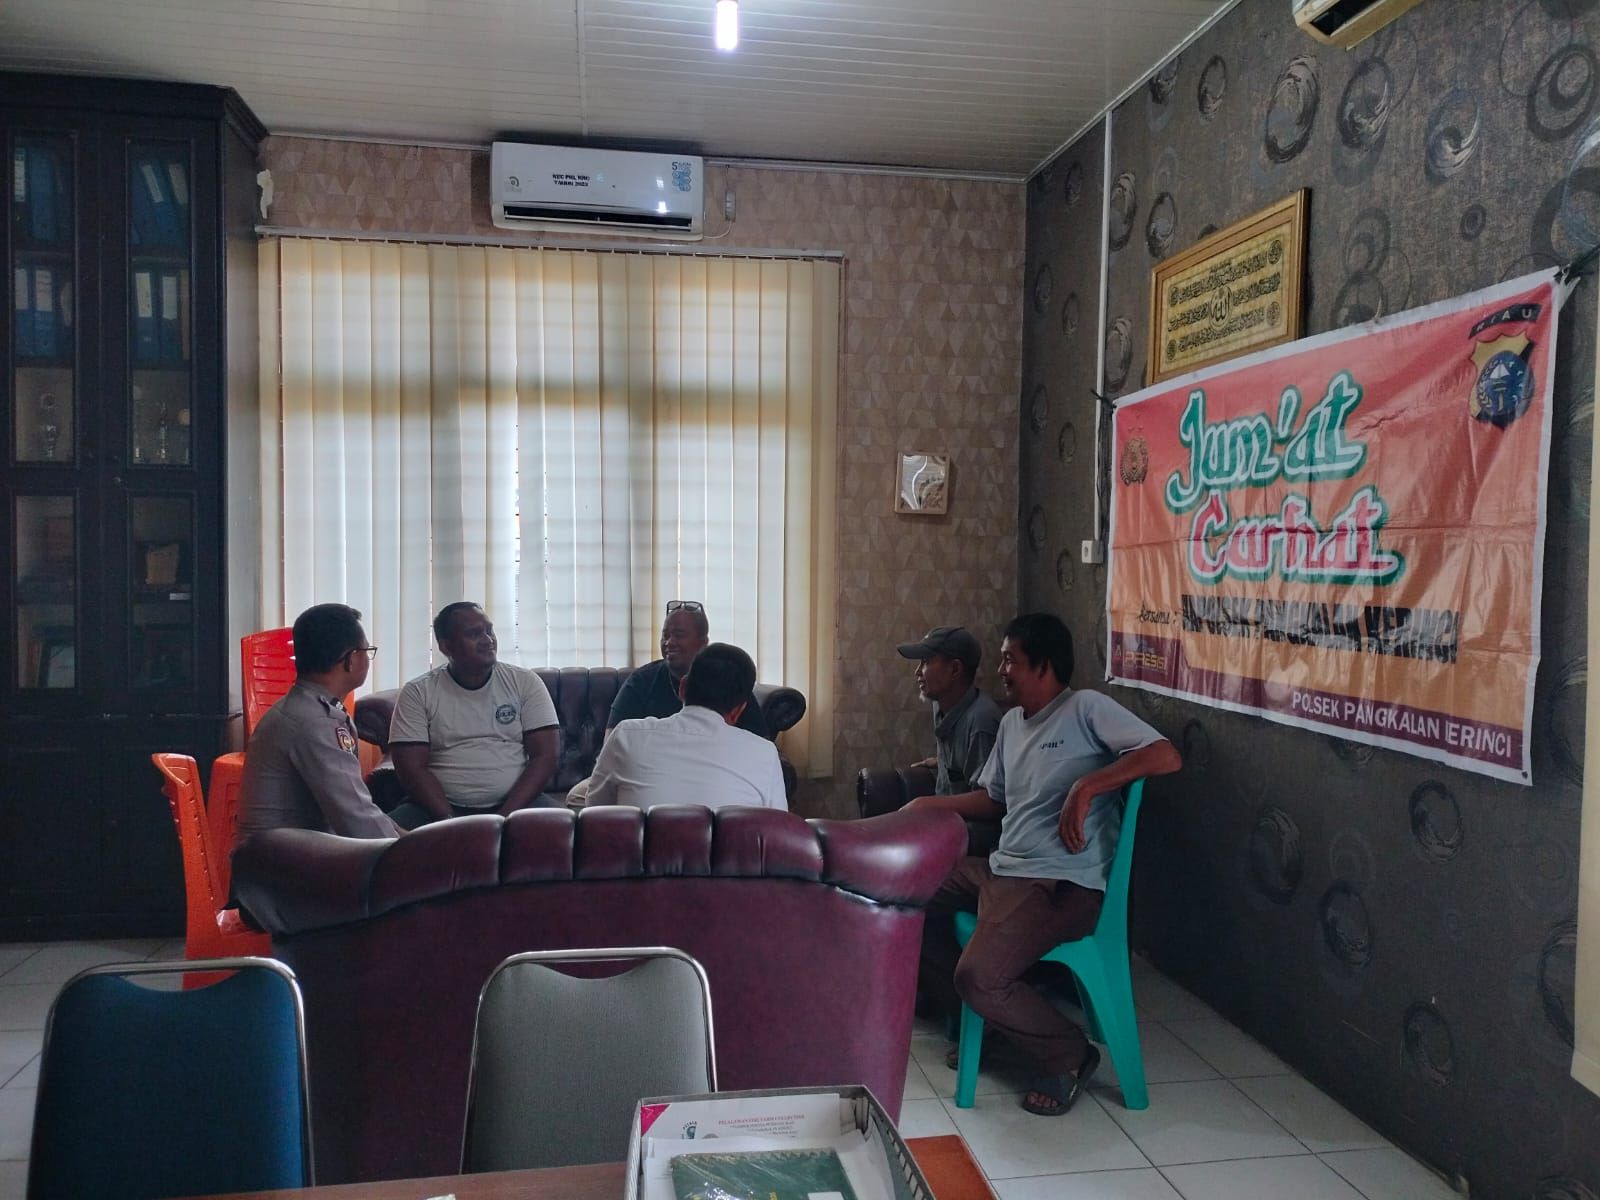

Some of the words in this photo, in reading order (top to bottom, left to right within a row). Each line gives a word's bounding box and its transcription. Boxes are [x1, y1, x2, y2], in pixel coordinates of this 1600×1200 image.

[1165, 369, 1367, 515] Jum'at
[1292, 691, 1340, 719] POLSEK
[1344, 702, 1440, 740] PANGKALAN
